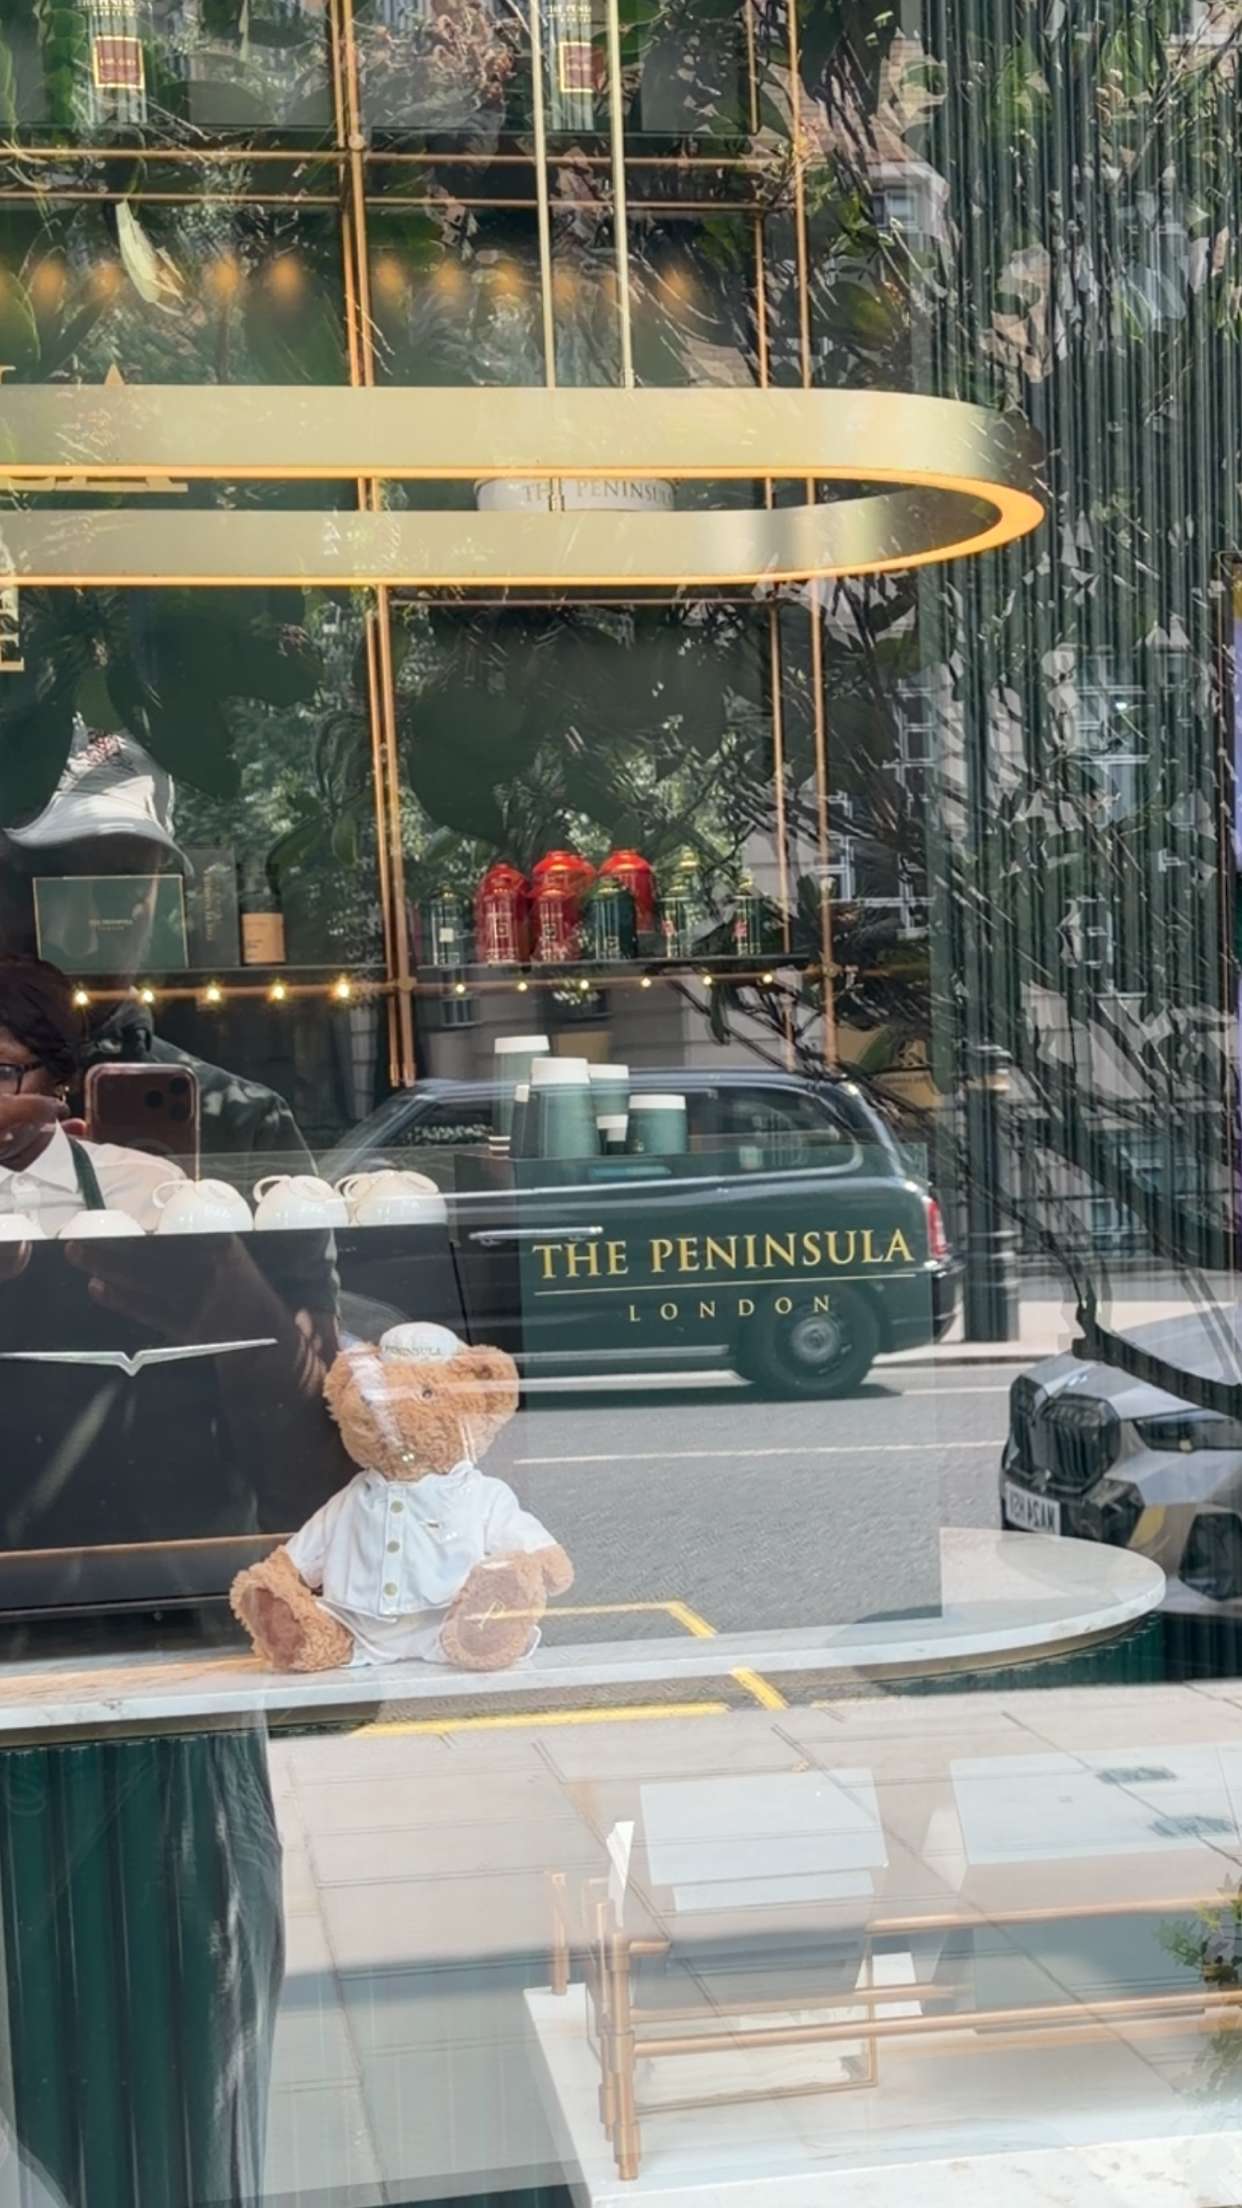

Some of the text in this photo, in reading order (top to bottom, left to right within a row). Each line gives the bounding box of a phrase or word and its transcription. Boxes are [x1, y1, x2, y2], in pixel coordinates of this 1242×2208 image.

[532, 1228, 915, 1279] THE PENINSULA
[629, 1295, 831, 1323] LONDON
